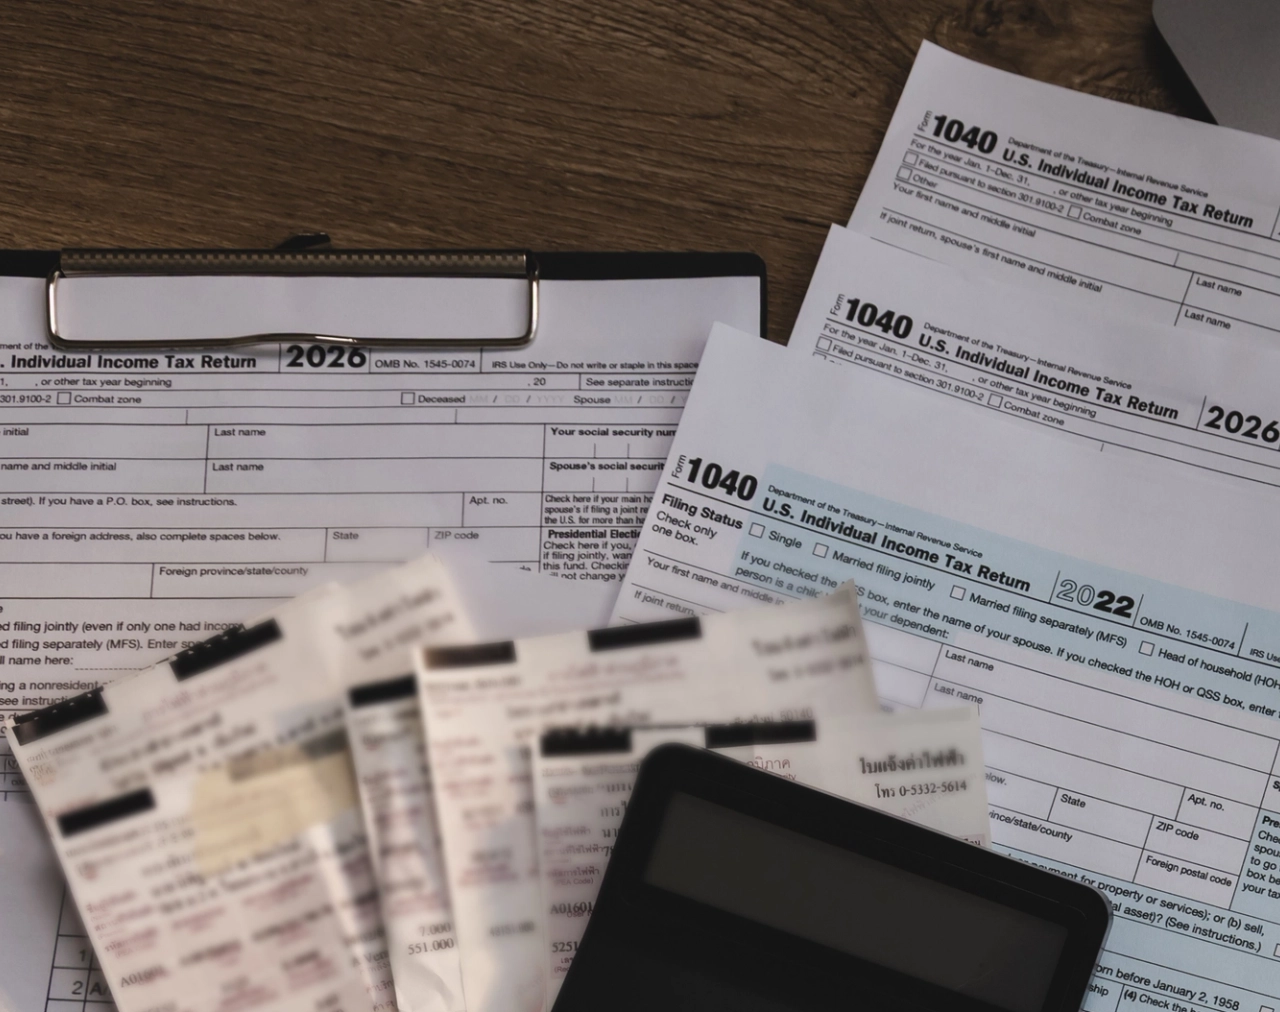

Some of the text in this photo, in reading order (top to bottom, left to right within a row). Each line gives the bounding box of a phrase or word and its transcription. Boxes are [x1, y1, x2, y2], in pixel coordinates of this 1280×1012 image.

[916, 109, 998, 154] Form 1040
[1001, 147, 1254, 229] U.S. Individual Income Tax Return
[1195, 276, 1243, 297] Last name
[845, 298, 914, 339] 1040
[10, 353, 92, 369] Individual
[96, 354, 159, 369] Income
[163, 354, 195, 369] Tax
[200, 354, 257, 369] Return
[285, 343, 369, 370] 2026
[374, 358, 476, 369] OMB No. 1545-0074
[917, 332, 1179, 420] U.S. Individual Income Tax Return
[73, 393, 142, 404] Combat zone
[2, 427, 30, 436] initial
[213, 427, 267, 437] Last name
[1203, 405, 1280, 444] 2026
[670, 453, 758, 501] Form 1040
[660, 492, 744, 530] Filing Status
[434, 530, 480, 540] ZIP code
[761, 496, 1031, 593] U.S. Individual Income Tax Return
[767, 529, 803, 549] Single
[1055, 578, 1135, 619] 2022
[898, 779, 968, 797] 0-5332-5614
[1059, 792, 1087, 809] State
[1186, 793, 1225, 812] Apt. no.
[1155, 820, 1200, 841] ZIP code
